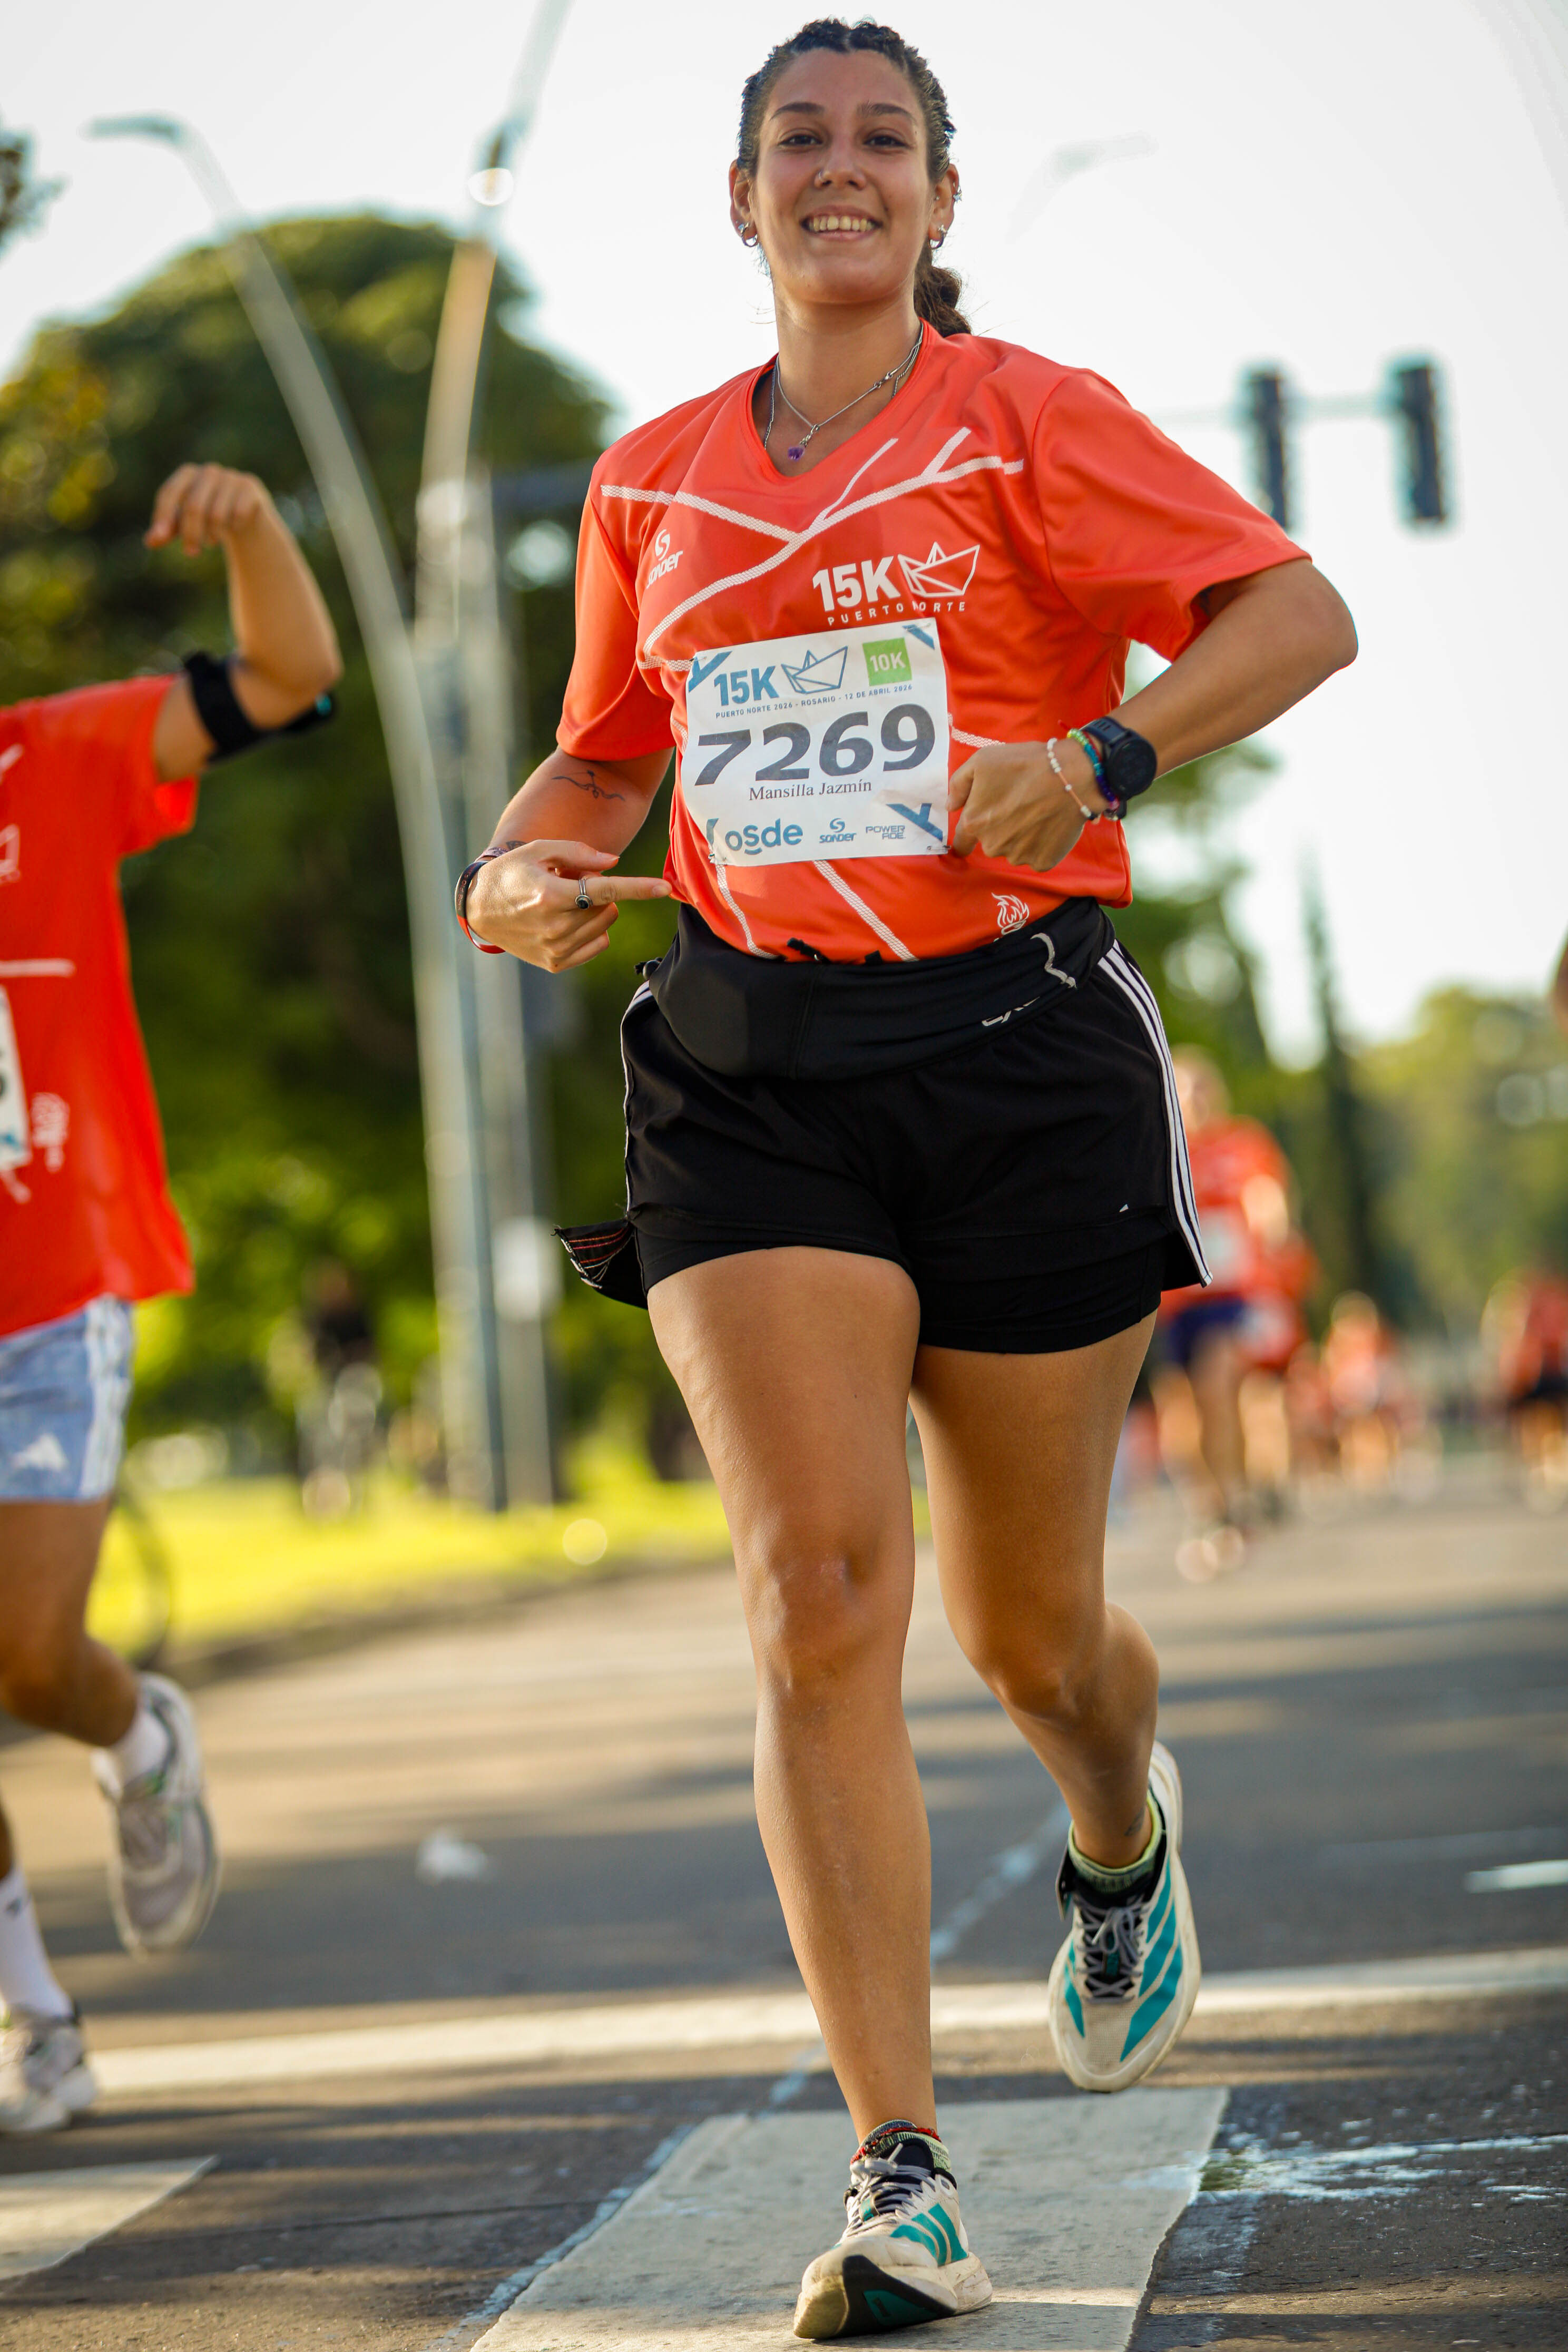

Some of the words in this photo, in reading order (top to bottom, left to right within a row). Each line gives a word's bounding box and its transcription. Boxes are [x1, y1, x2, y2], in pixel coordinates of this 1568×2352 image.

[812, 556, 901, 612] 15K
[827, 603, 904, 626] PUERTO
[869, 651, 907, 673] 10K
[713, 665, 780, 707] 15K
[716, 708, 744, 719] PUERTO
[747, 705, 771, 714] NORTE
[774, 702, 793, 710] 2026
[801, 695, 836, 707] ROSARIO
[868, 687, 890, 697] ABRIL
[894, 684, 913, 692] 2026
[694, 703, 936, 787] 7269
[749, 783, 815, 801] Mansilla
[819, 779, 873, 796] Jazmín
[724, 818, 804, 852] osde
[865, 825, 906, 835] POWER
